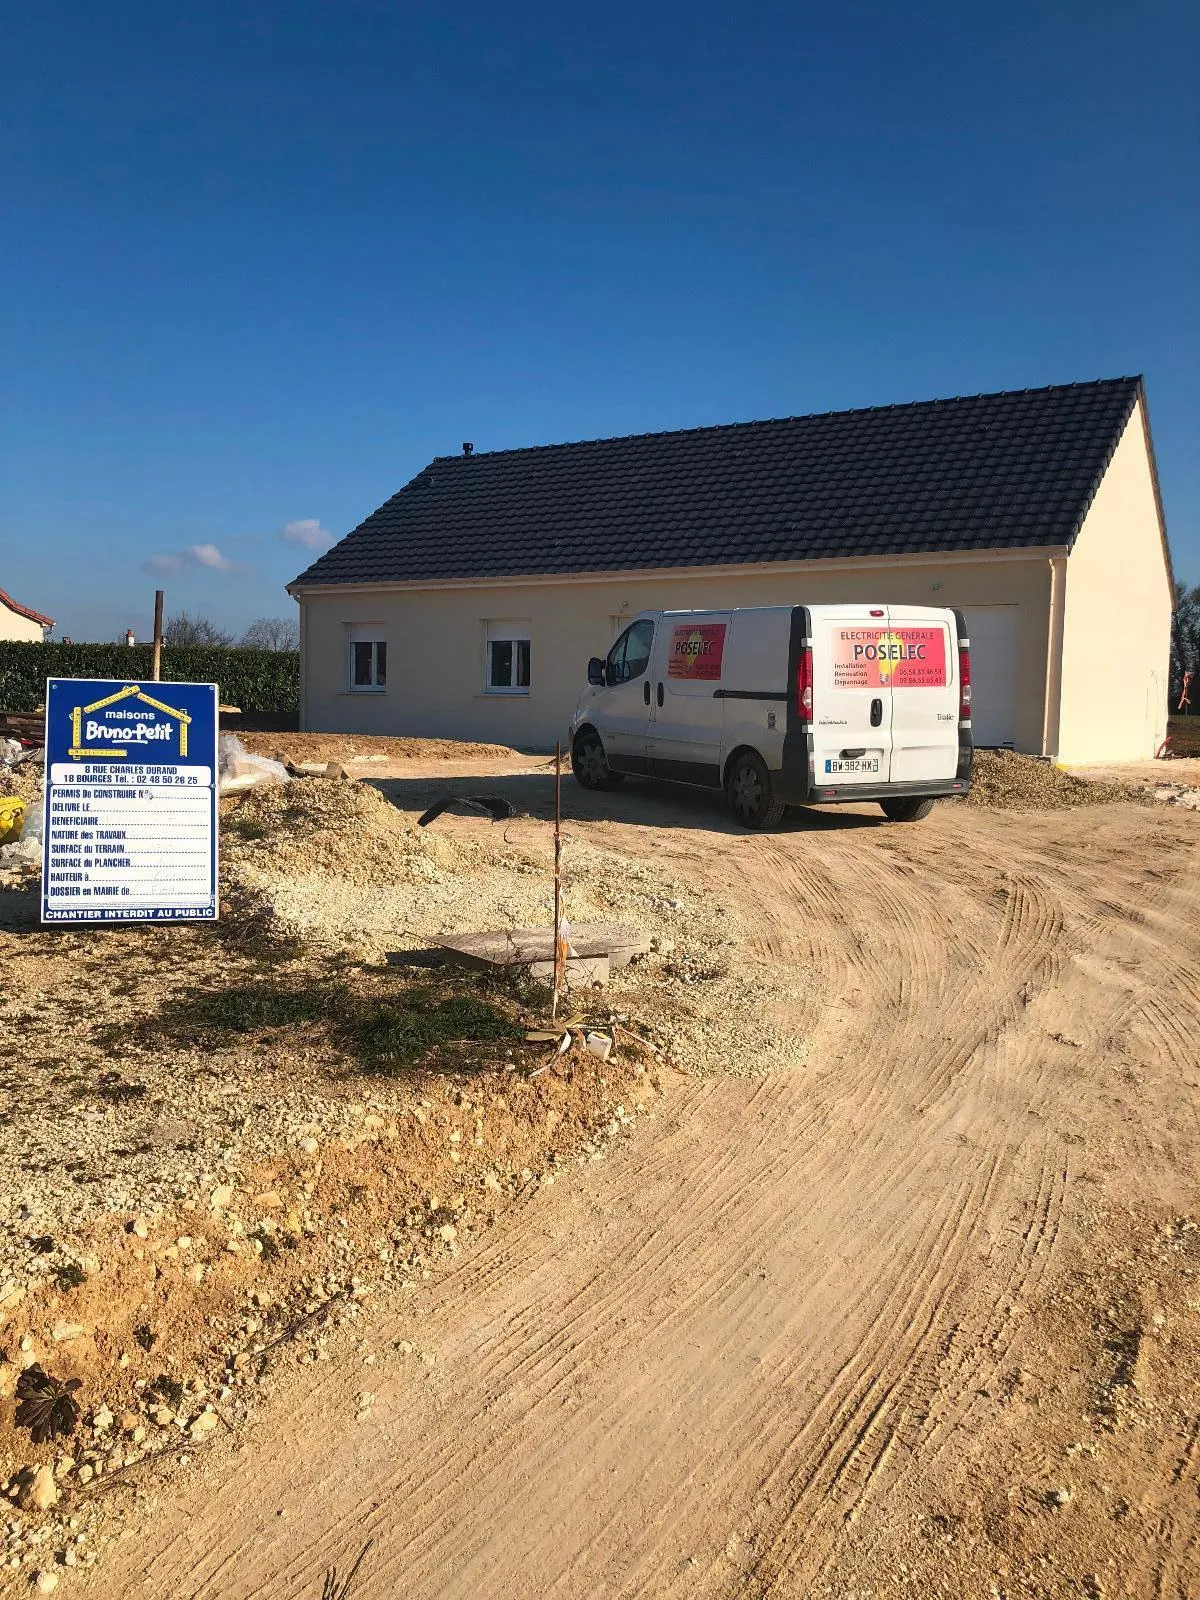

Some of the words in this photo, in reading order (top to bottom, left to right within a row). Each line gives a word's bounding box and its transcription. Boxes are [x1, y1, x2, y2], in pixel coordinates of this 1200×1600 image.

[674, 641, 715, 656] POSELEC
[853, 644, 926, 660] POSELEC
[105, 710, 156, 720] maisons
[86, 720, 174, 740] Bruno-Petit
[84, 766, 90, 774] 8
[92, 766, 108, 774] RUE
[110, 766, 144, 774] CHARLES
[146, 766, 178, 775] DURAND
[64, 774, 74, 783] 18
[76, 774, 112, 783] BOURGES
[150, 776, 159, 784] 48
[162, 776, 172, 784] 50
[175, 776, 185, 784] 26
[188, 776, 198, 784] 25
[52, 789, 80, 798] PERMIS
[83, 790, 91, 798] De
[94, 789, 136, 798] CONSTRUIRE
[52, 803, 80, 812] DELIVRE
[82, 803, 90, 812] LE
[52, 816, 98, 826] BENEFICIAIRE
[52, 831, 78, 840] NATURE
[80, 831, 93, 840] des
[96, 831, 126, 840] TRAVAUX
[51, 844, 82, 853] SURFACE
[84, 844, 93, 853] du
[95, 844, 125, 853] TERRAIN
[51, 858, 81, 867] SURFACE
[84, 858, 92, 867] du
[94, 858, 131, 867] PLANCHER
[51, 872, 82, 881] HAUTEUR
[84, 872, 89, 881] à
[51, 887, 80, 896] DOSSIER
[94, 887, 119, 896] MAIRIE
[122, 886, 130, 896] de
[46, 910, 101, 919] CHANTIER
[105, 910, 154, 918] INTERDIT
[157, 909, 172, 917] AU
[175, 908, 213, 917] PUBLIC
